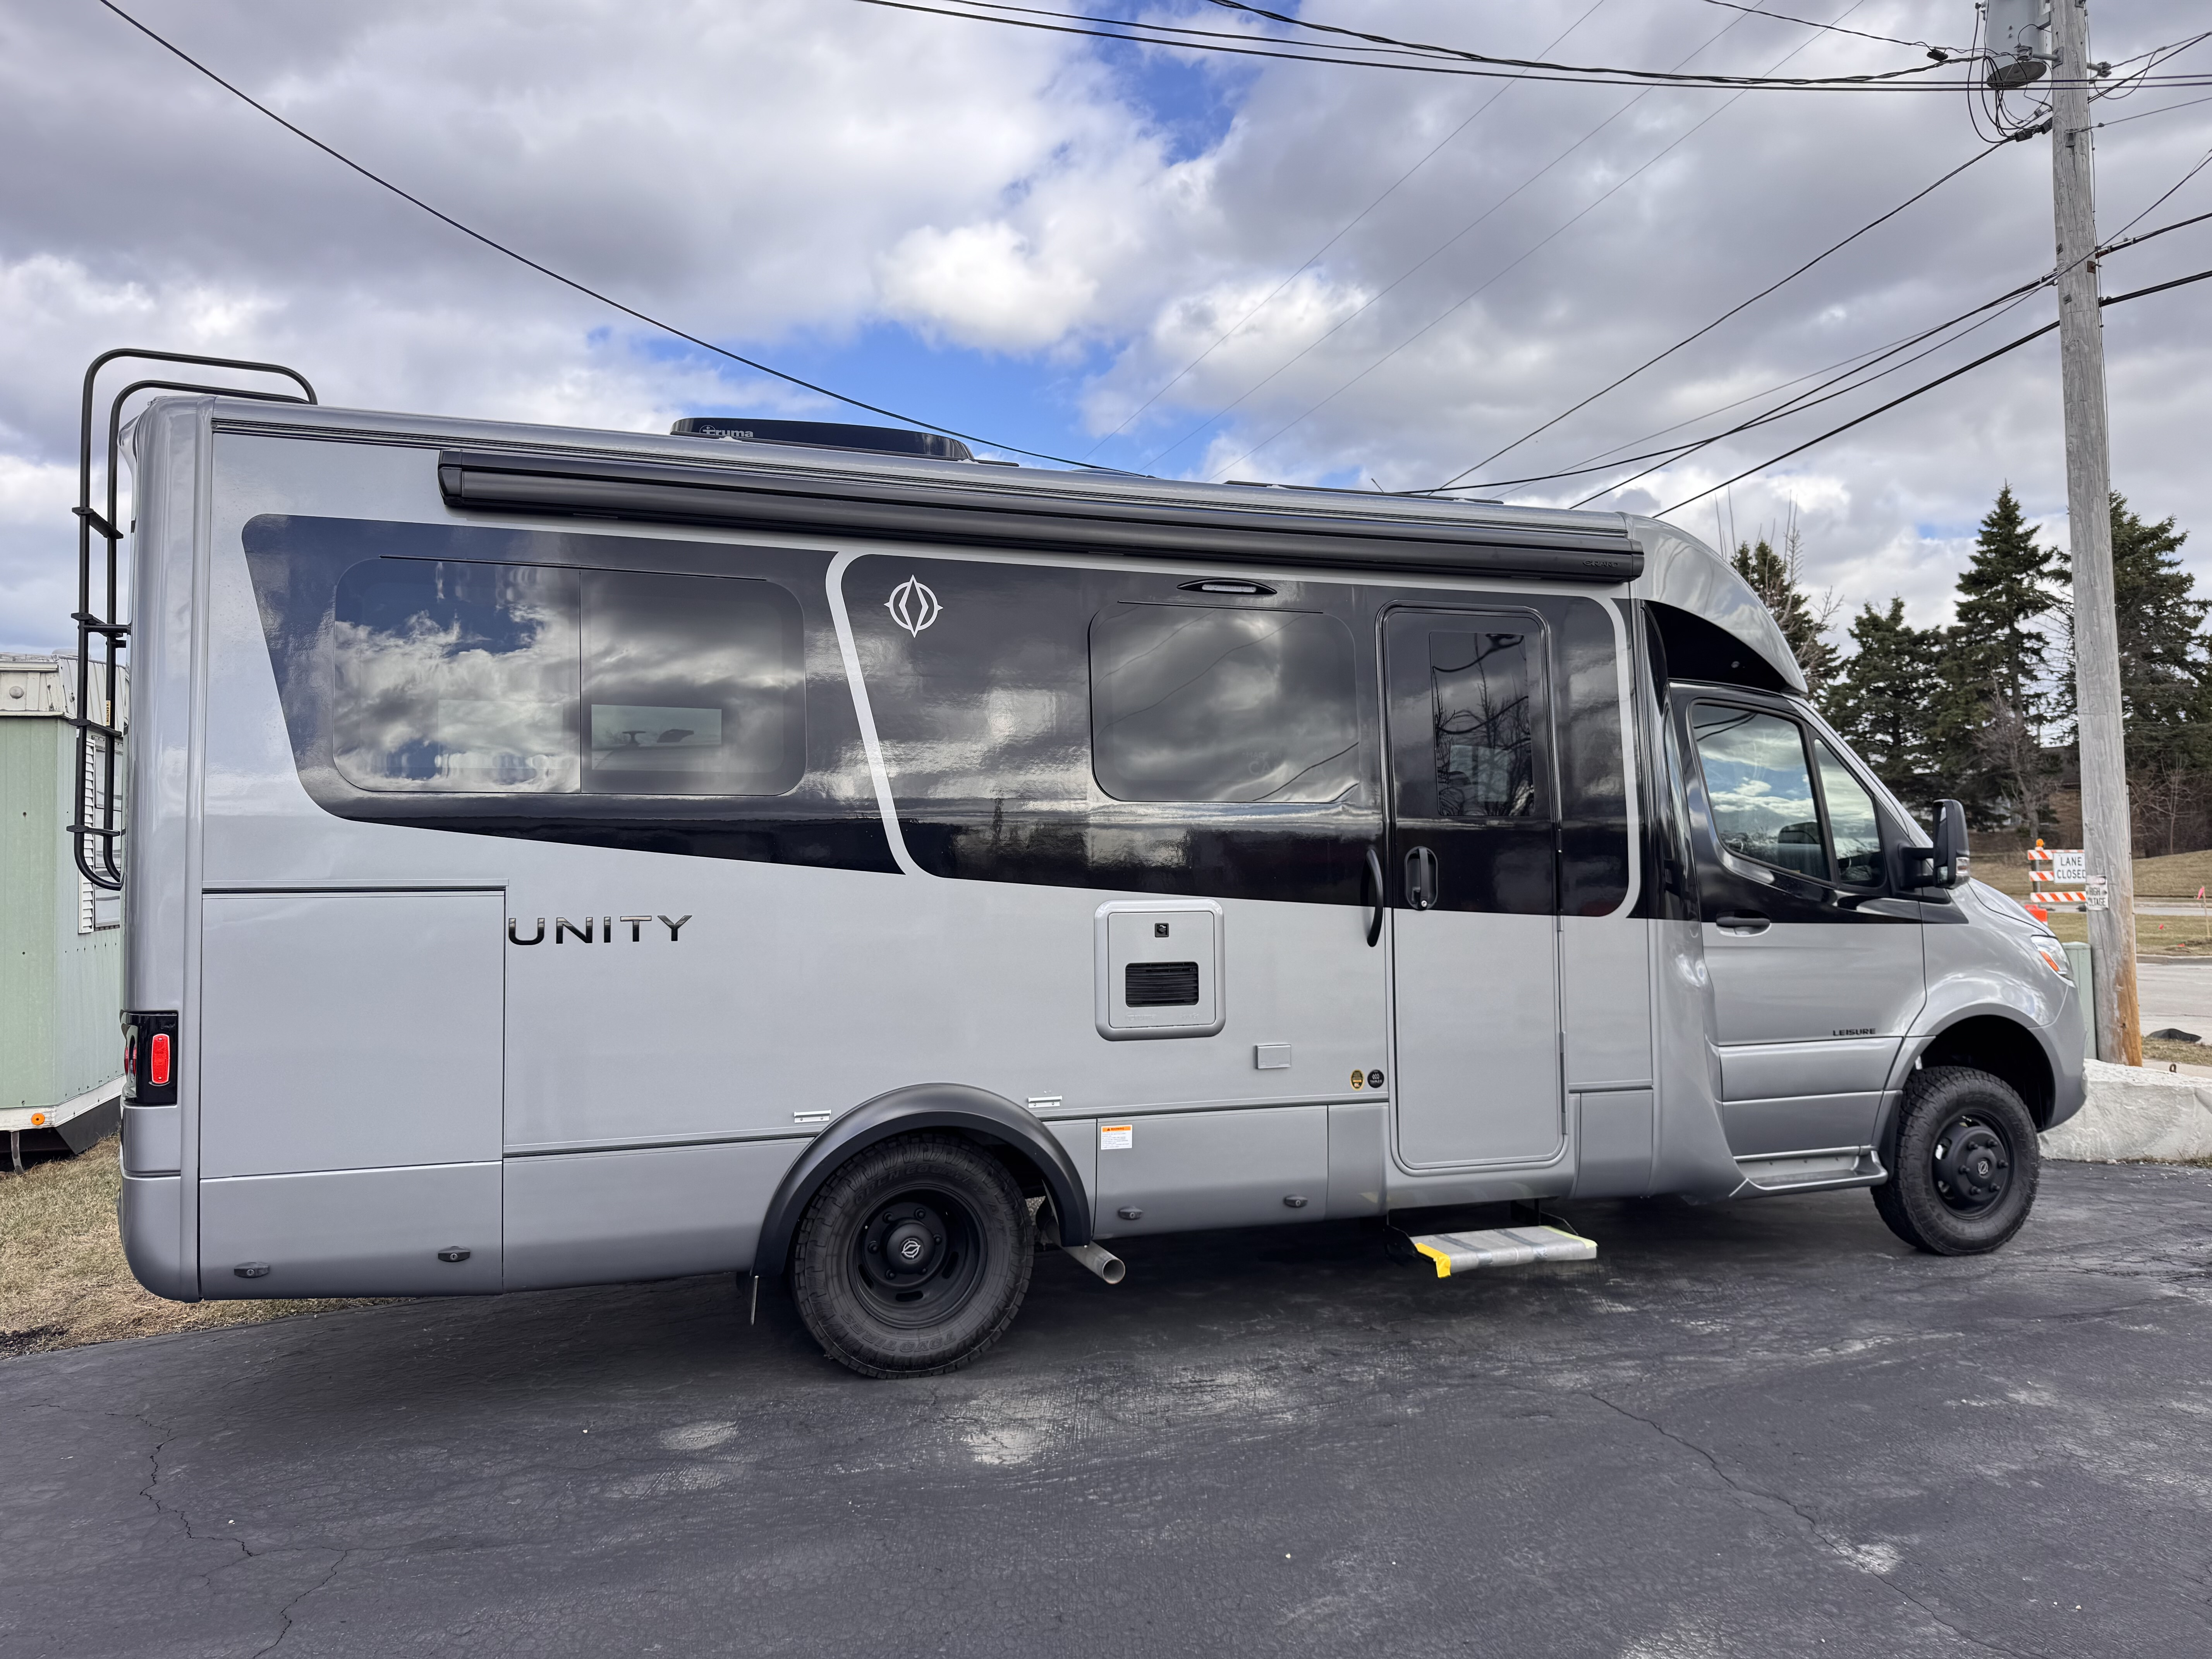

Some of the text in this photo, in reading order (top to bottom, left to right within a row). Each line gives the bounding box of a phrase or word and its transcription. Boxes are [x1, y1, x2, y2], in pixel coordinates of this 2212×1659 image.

[2060, 857, 2082, 866] LANE
[2057, 869, 2086, 879] CLOSED
[2088, 897, 2106, 906] OLTAGE
[508, 915, 692, 946] UNITY
[854, 1168, 901, 1204] OPEN
[840, 1313, 956, 1352] TOYO TIRES
